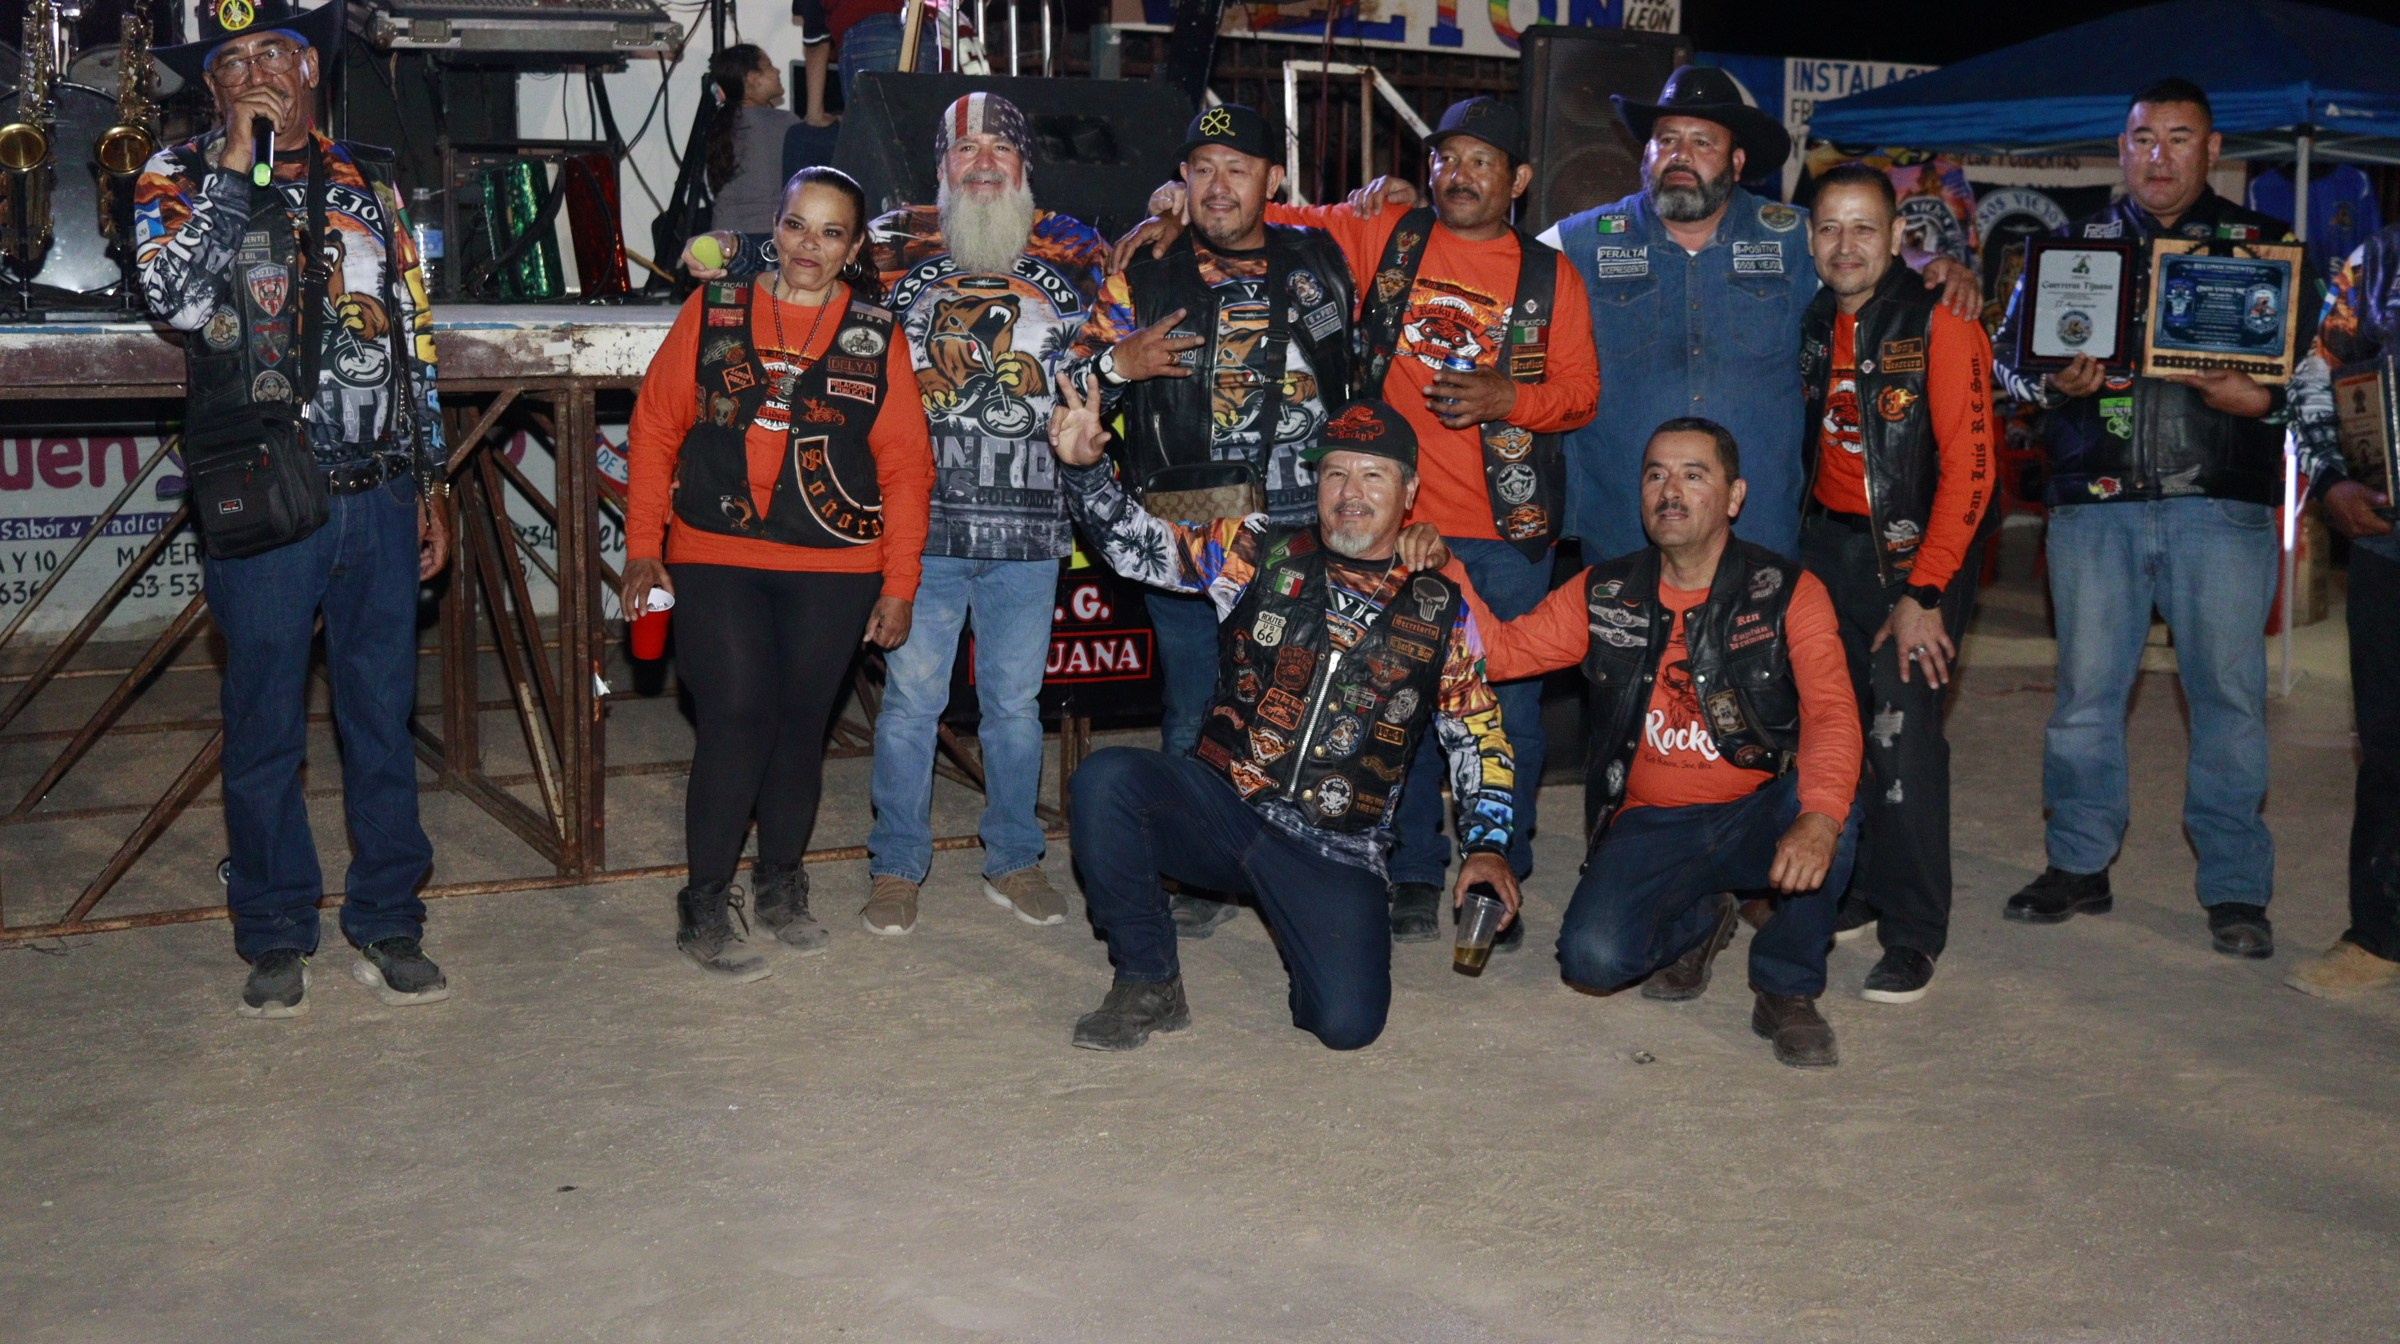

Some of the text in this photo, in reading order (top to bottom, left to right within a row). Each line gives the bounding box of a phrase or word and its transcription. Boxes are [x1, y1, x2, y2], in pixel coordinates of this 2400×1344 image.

[287, 187, 383, 230] VEJO
[1600, 249, 1645, 259] PERALTA
[897, 258, 1074, 306] OSOS EJOS
[1420, 305, 1479, 329] Rocky Point
[1513, 318, 1547, 327] MEXICO
[1431, 337, 1453, 349] SLRC
[830, 357, 874, 374] DELYA
[831, 380, 873, 395] RELACIONES
[766, 400, 790, 411] SLRC
[597, 449, 619, 475] DE
[1971, 443, 1986, 482] Luis
[799, 448, 882, 536] Sonora
[1963, 490, 1982, 527] San
[2, 516, 62, 541] Sabór
[70, 521, 82, 538] y
[12, 550, 57, 574] Y 10
[1261, 612, 1283, 626] ROUTE
[1257, 628, 1275, 644] 66
